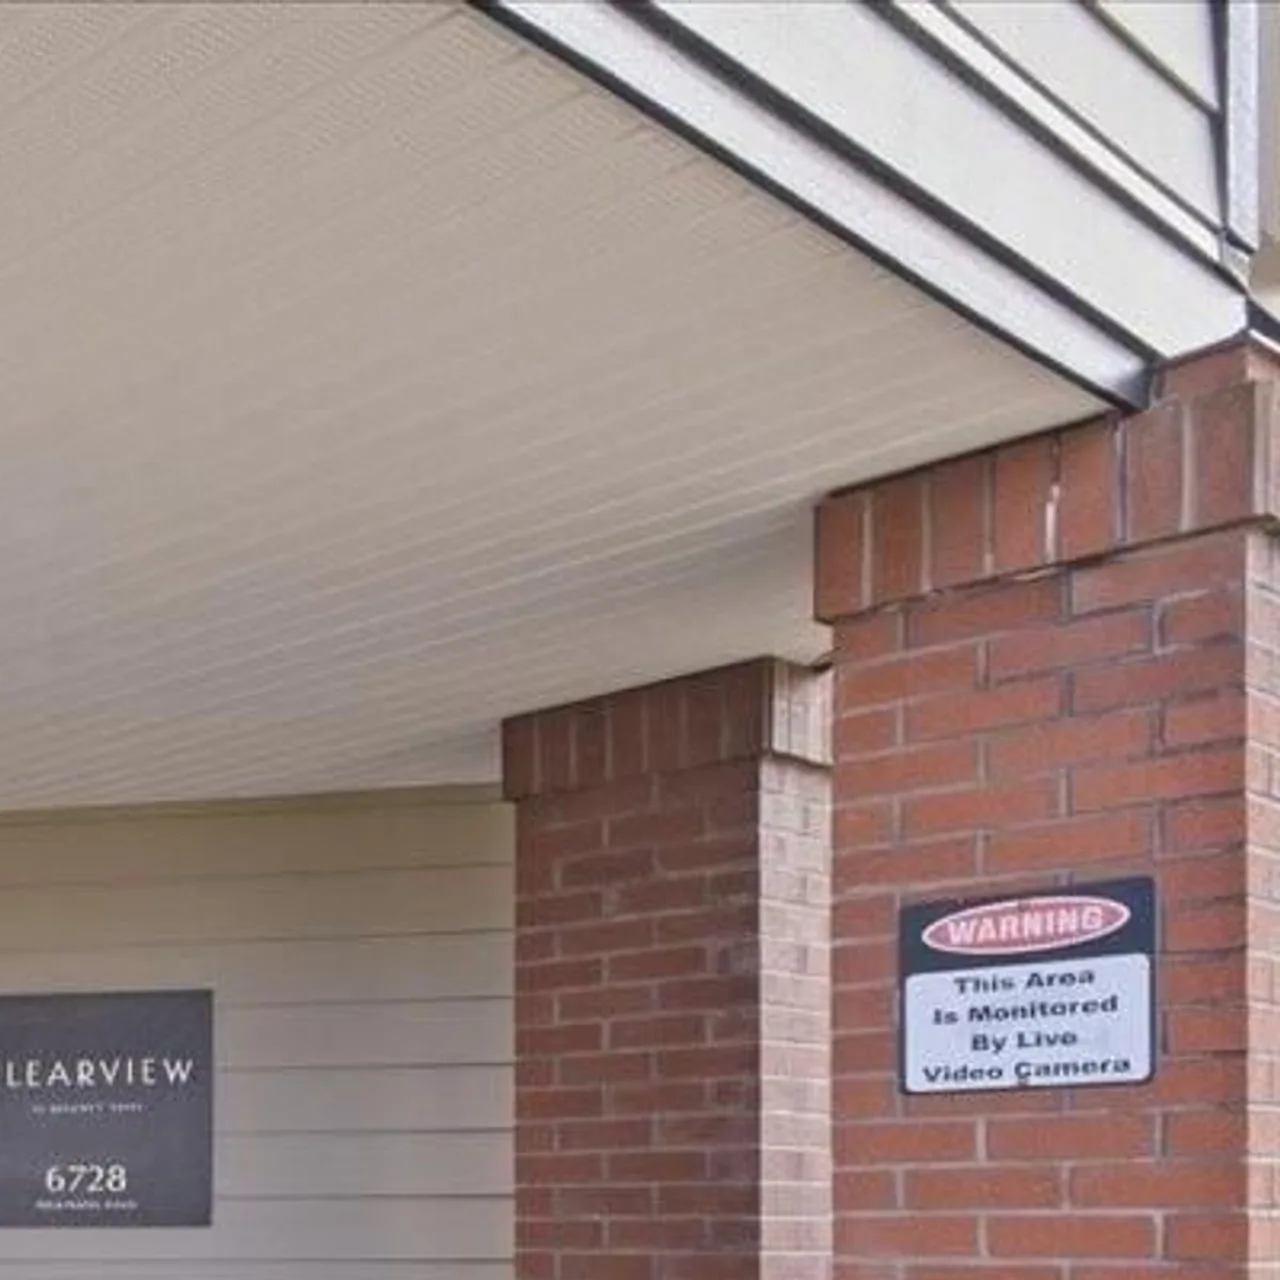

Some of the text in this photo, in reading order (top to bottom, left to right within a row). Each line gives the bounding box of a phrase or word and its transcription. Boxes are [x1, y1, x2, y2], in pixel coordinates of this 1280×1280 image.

[946, 905, 1105, 945] WARNING
[953, 969, 1096, 994] This Area
[933, 995, 1119, 1025] Is Monitored
[971, 1030, 1079, 1054] By Live
[923, 1057, 1132, 1083] Video Camera
[45, 1164, 128, 1193] 6728
